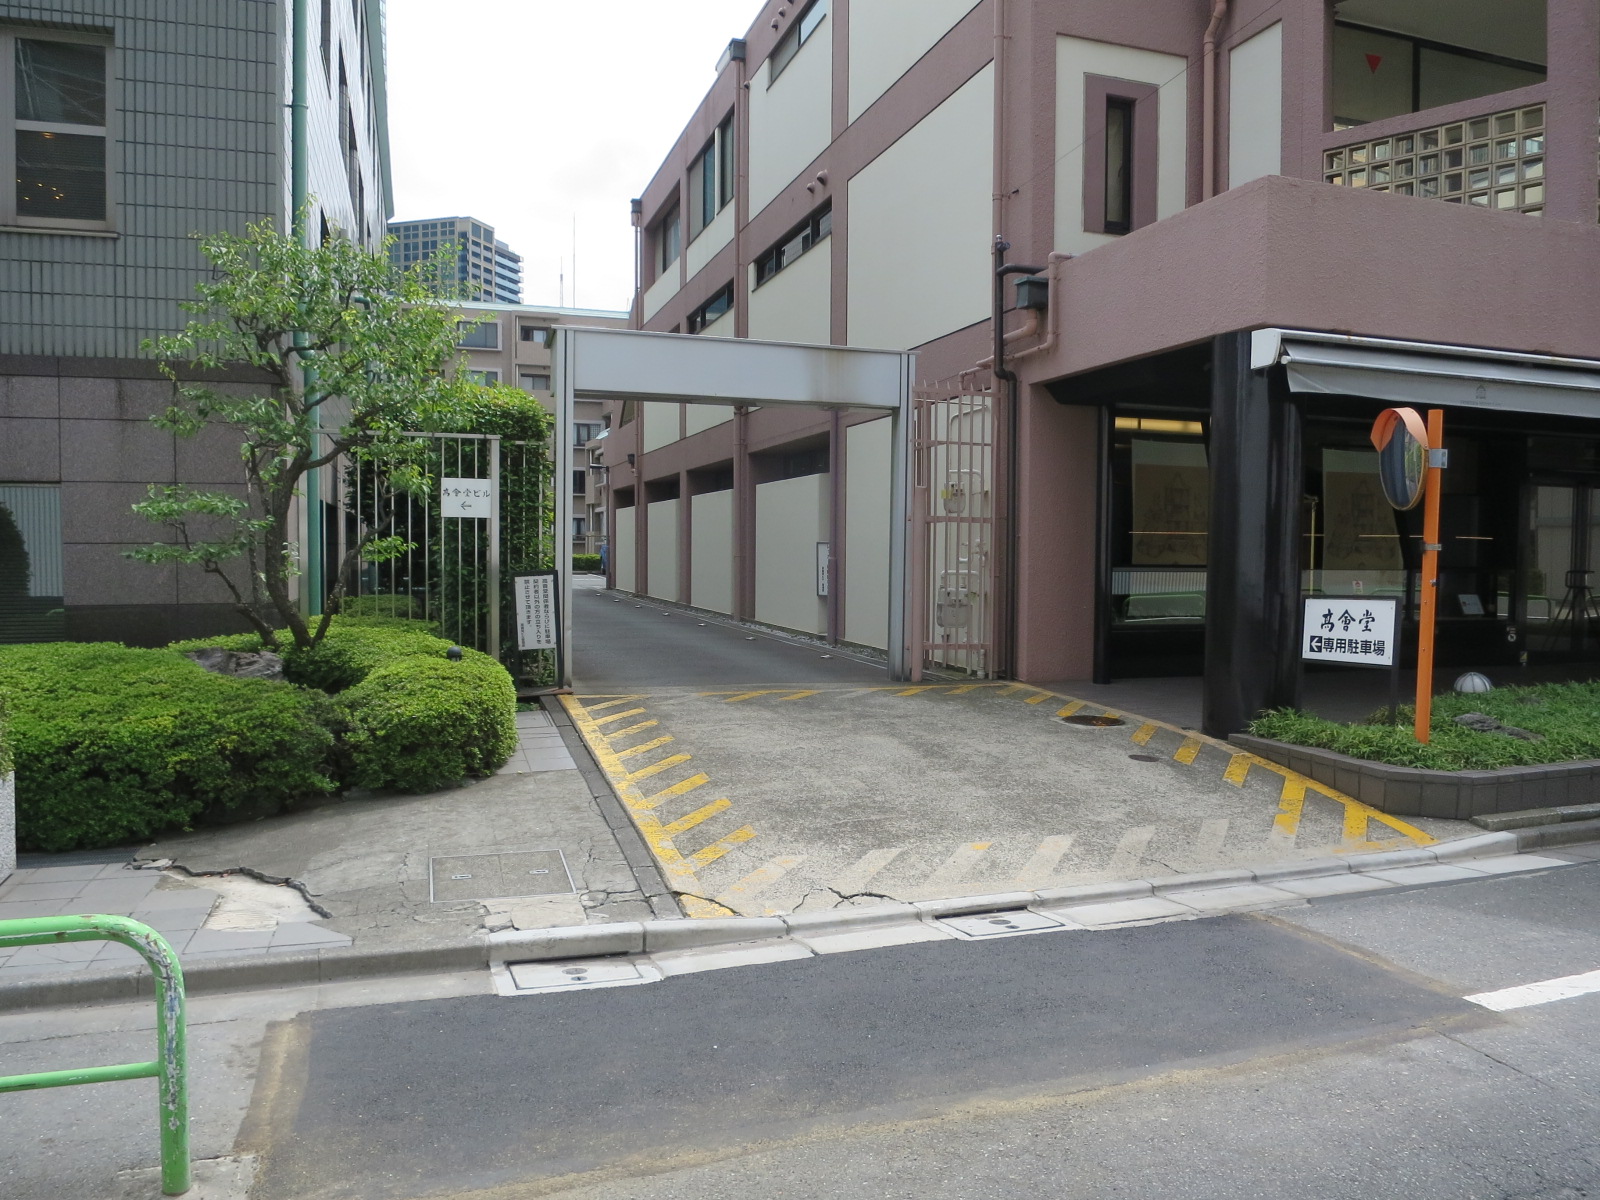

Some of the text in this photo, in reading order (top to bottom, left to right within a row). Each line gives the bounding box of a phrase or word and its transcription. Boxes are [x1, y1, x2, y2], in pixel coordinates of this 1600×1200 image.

[1323, 637, 1386, 657] 専用駐車場
